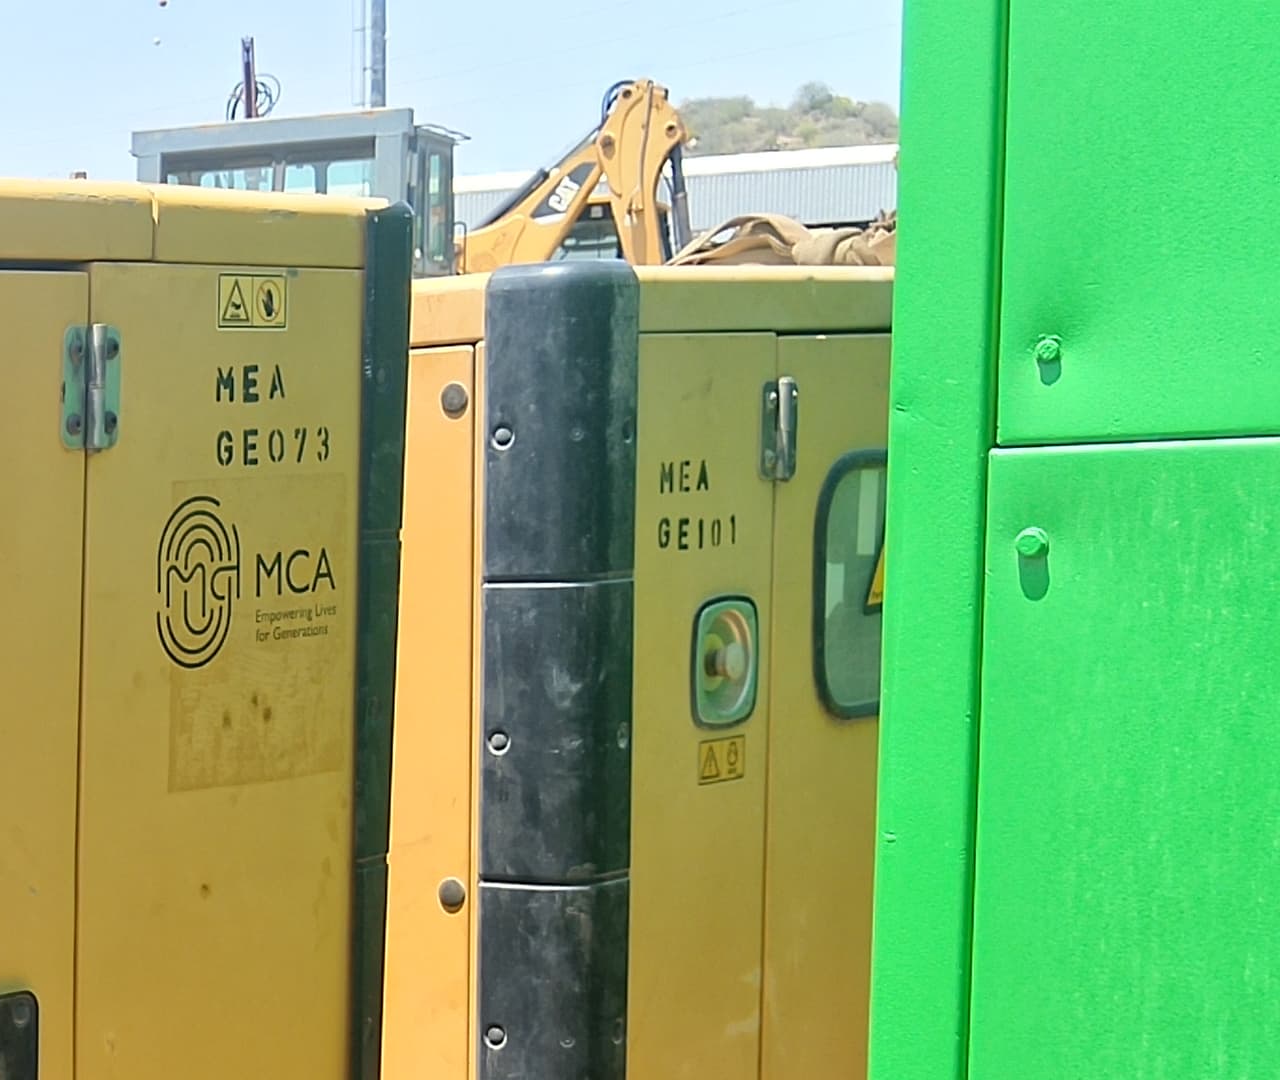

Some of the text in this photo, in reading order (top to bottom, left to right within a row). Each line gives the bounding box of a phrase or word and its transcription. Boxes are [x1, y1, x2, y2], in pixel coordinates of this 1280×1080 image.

[548, 175, 580, 212] CAT
[215, 364, 285, 402] MEA
[216, 426, 330, 466] GE073
[659, 459, 709, 494] MEA
[255, 547, 336, 598] MCA
[255, 602, 337, 625] Empowering Lives
[255, 624, 329, 642] for Generations
